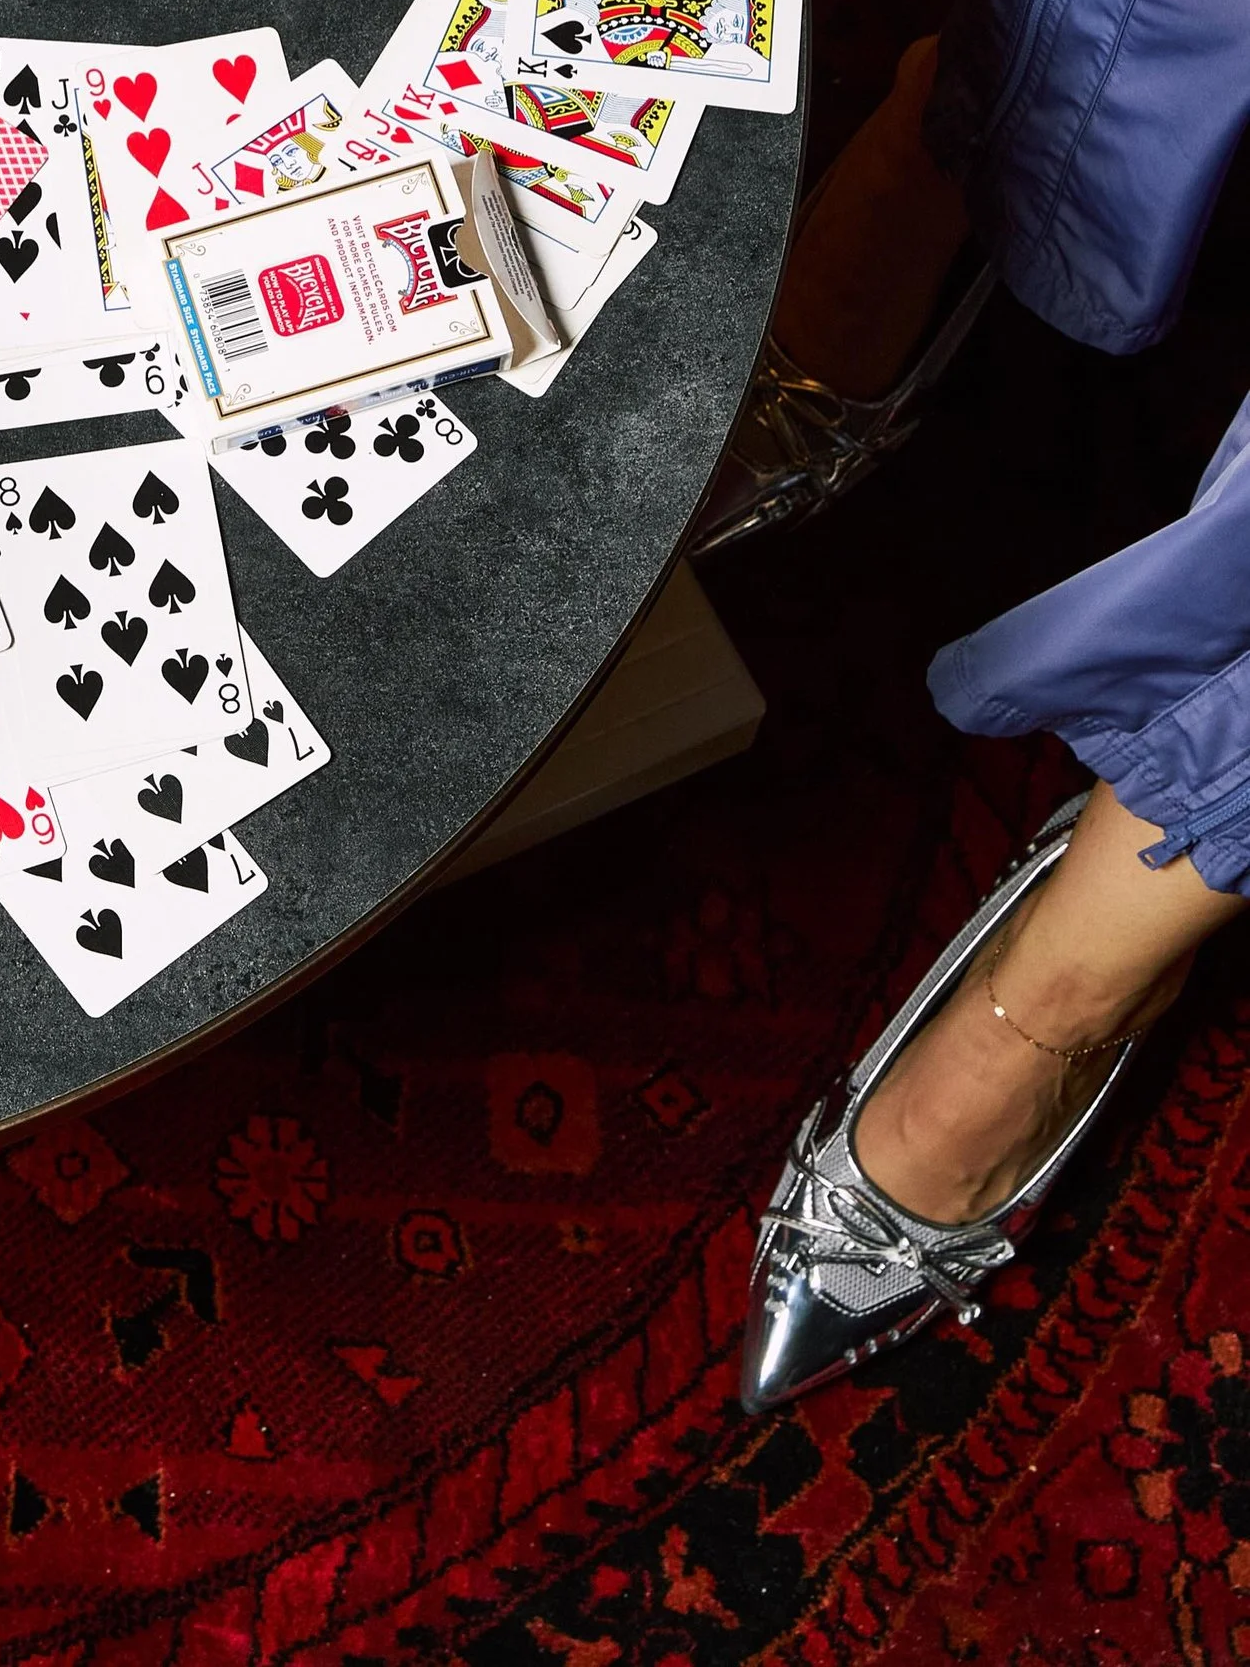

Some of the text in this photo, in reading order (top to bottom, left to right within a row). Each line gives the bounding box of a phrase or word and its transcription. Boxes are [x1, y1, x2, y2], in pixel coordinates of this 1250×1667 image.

[86, 68, 106, 97] 9
[517, 56, 548, 78] K
[51, 78, 70, 111] J
[402, 84, 435, 110] K
[364, 109, 390, 136] J
[345, 140, 378, 162] Q
[191, 162, 214, 196] J
[326, 217, 338, 236] AND
[333, 237, 353, 279] PRODUCT
[340, 219, 352, 238] FOR
[347, 239, 361, 264] MORE
[262, 275, 271, 288] FOR
[272, 304, 285, 332] ANDROID
[268, 270, 294, 333] HOW TO PLAY APP
[277, 259, 329, 330] BICYCLE
[168, 262, 217, 394] STANDARD SIZE STANDARD FACE
[199, 289, 214, 320] 73854
[209, 323, 226, 355] 60808
[435, 418, 464, 445] 8
[0, 477, 21, 506] 8
[218, 683, 240, 714] 8
[288, 727, 315, 761] 7
[230, 853, 257, 885] 7
